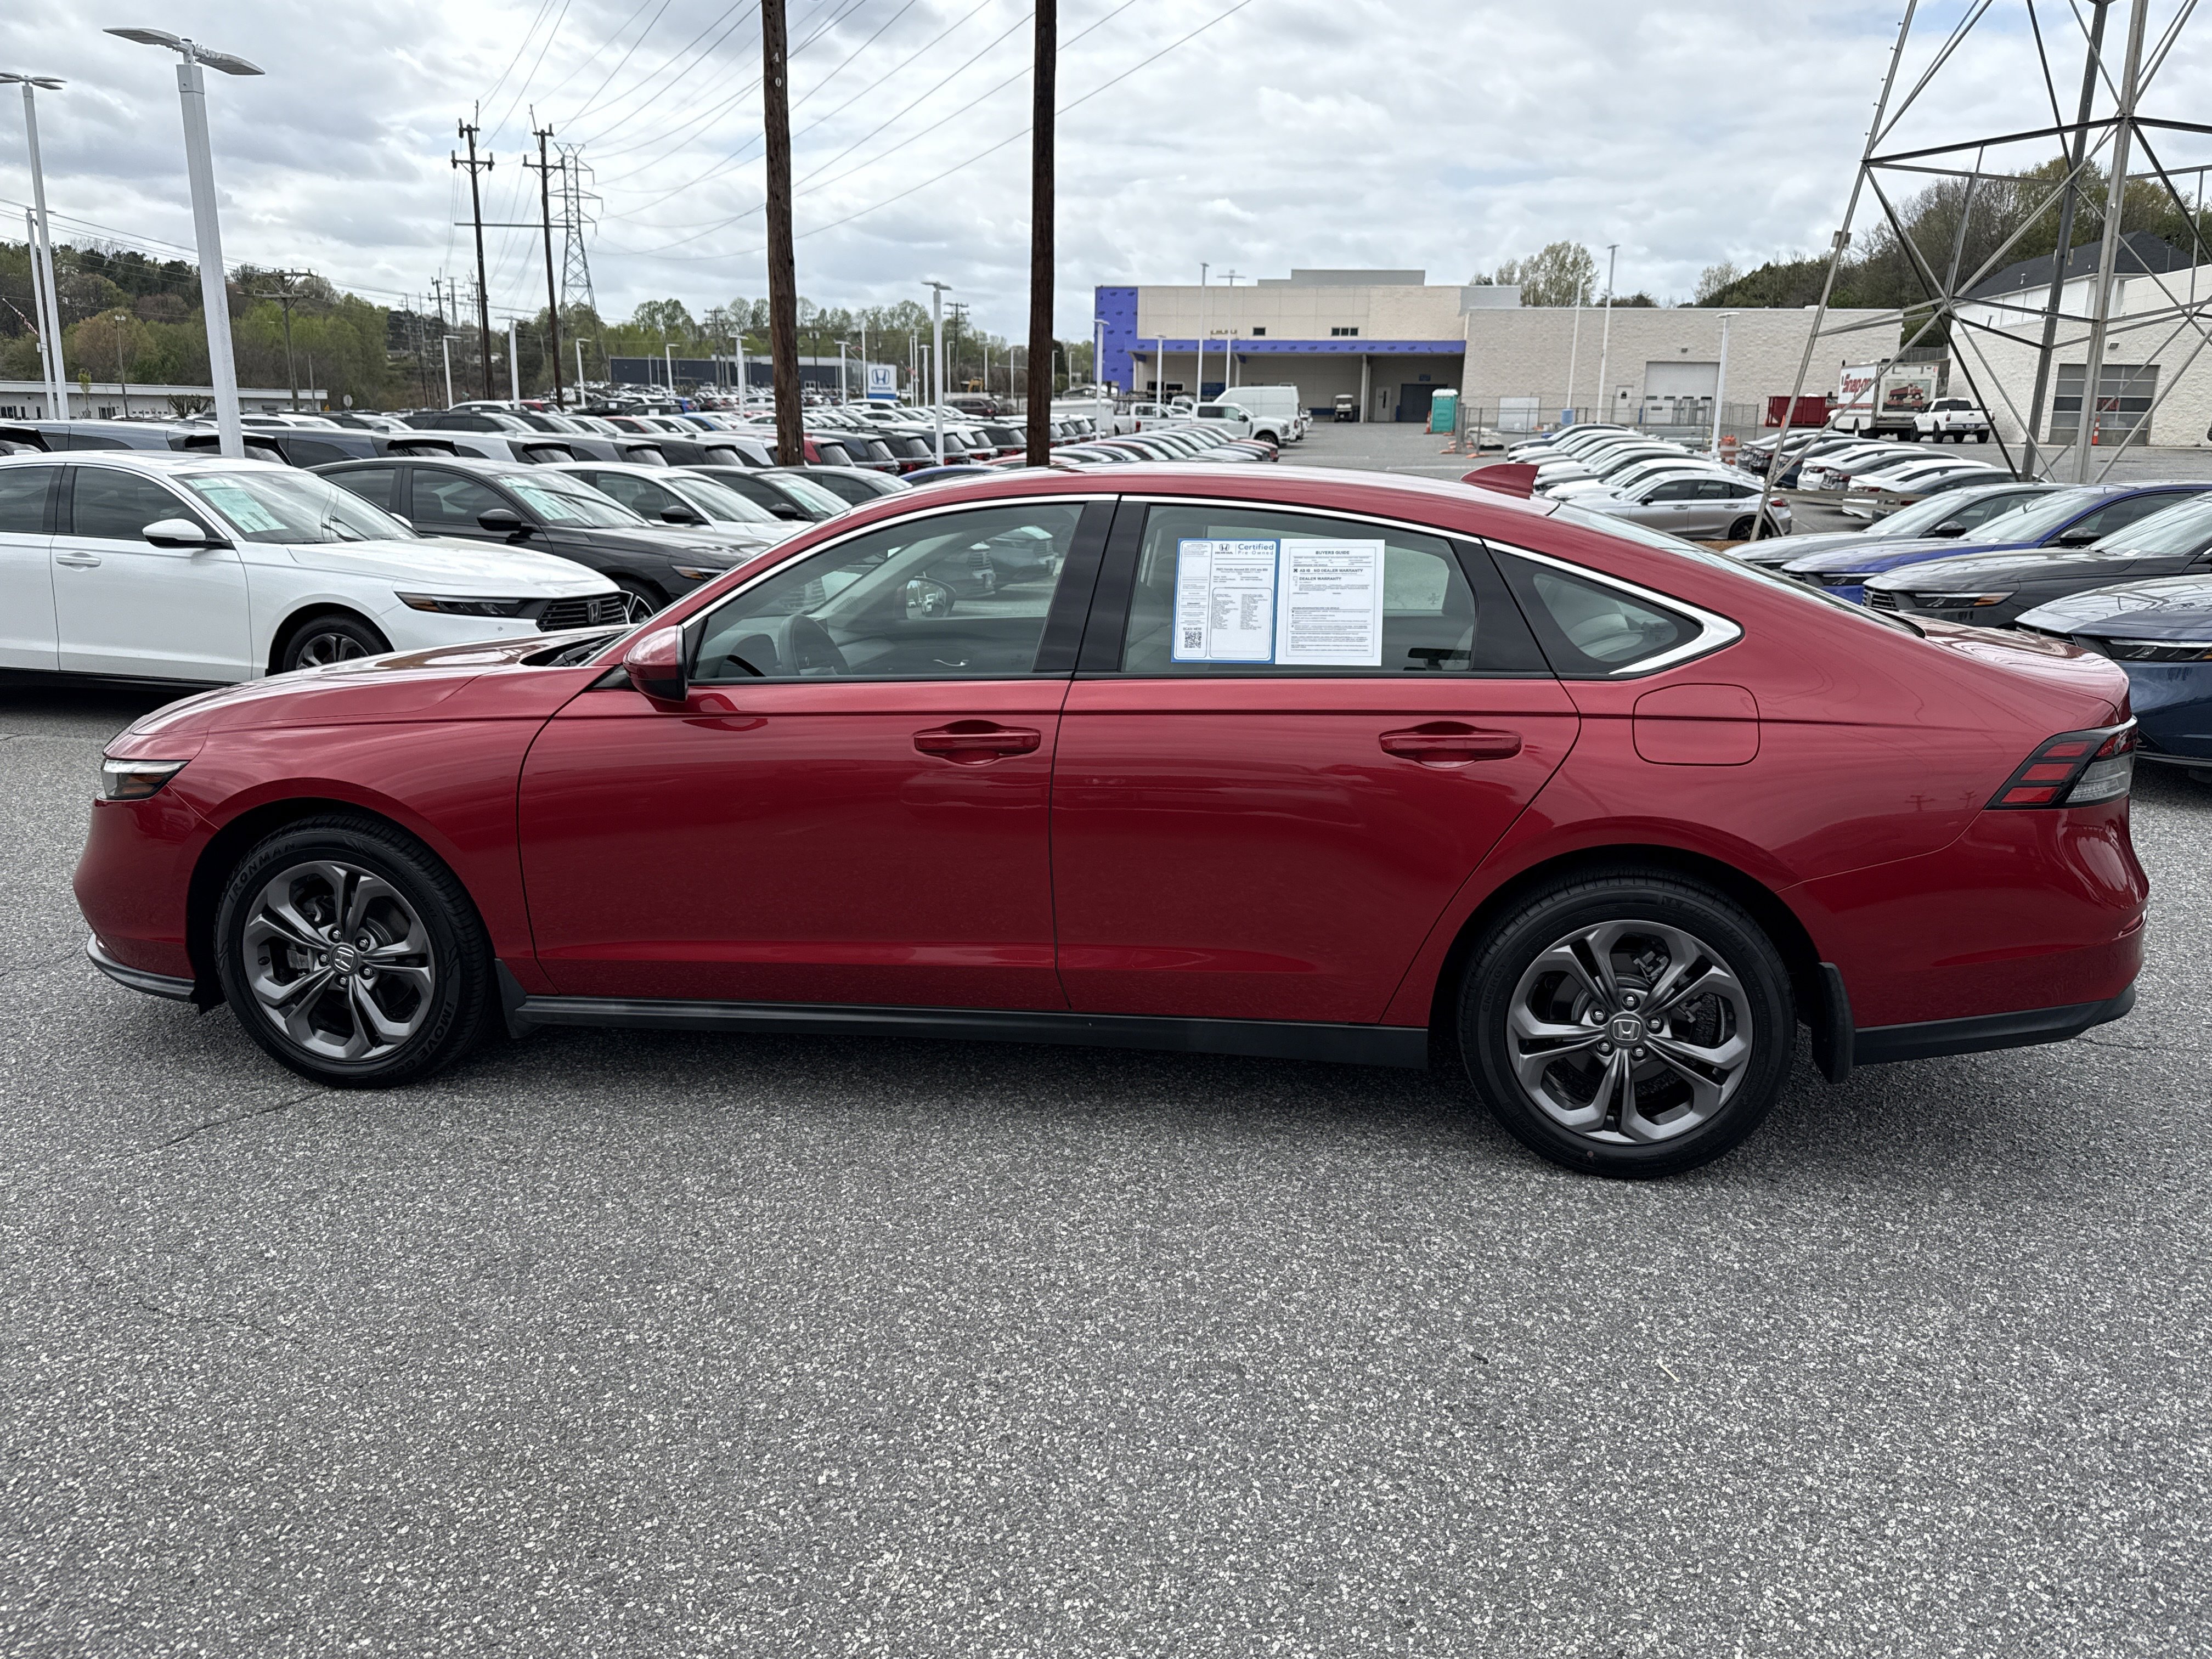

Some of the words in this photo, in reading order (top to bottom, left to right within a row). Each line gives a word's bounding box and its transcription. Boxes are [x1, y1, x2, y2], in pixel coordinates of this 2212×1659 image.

[228, 842, 295, 904] IRONMAN
[1682, 901, 1747, 949] MICHELIN
[1482, 963, 1506, 1012] ENERGY
[417, 1001, 455, 1060] iMOVE
